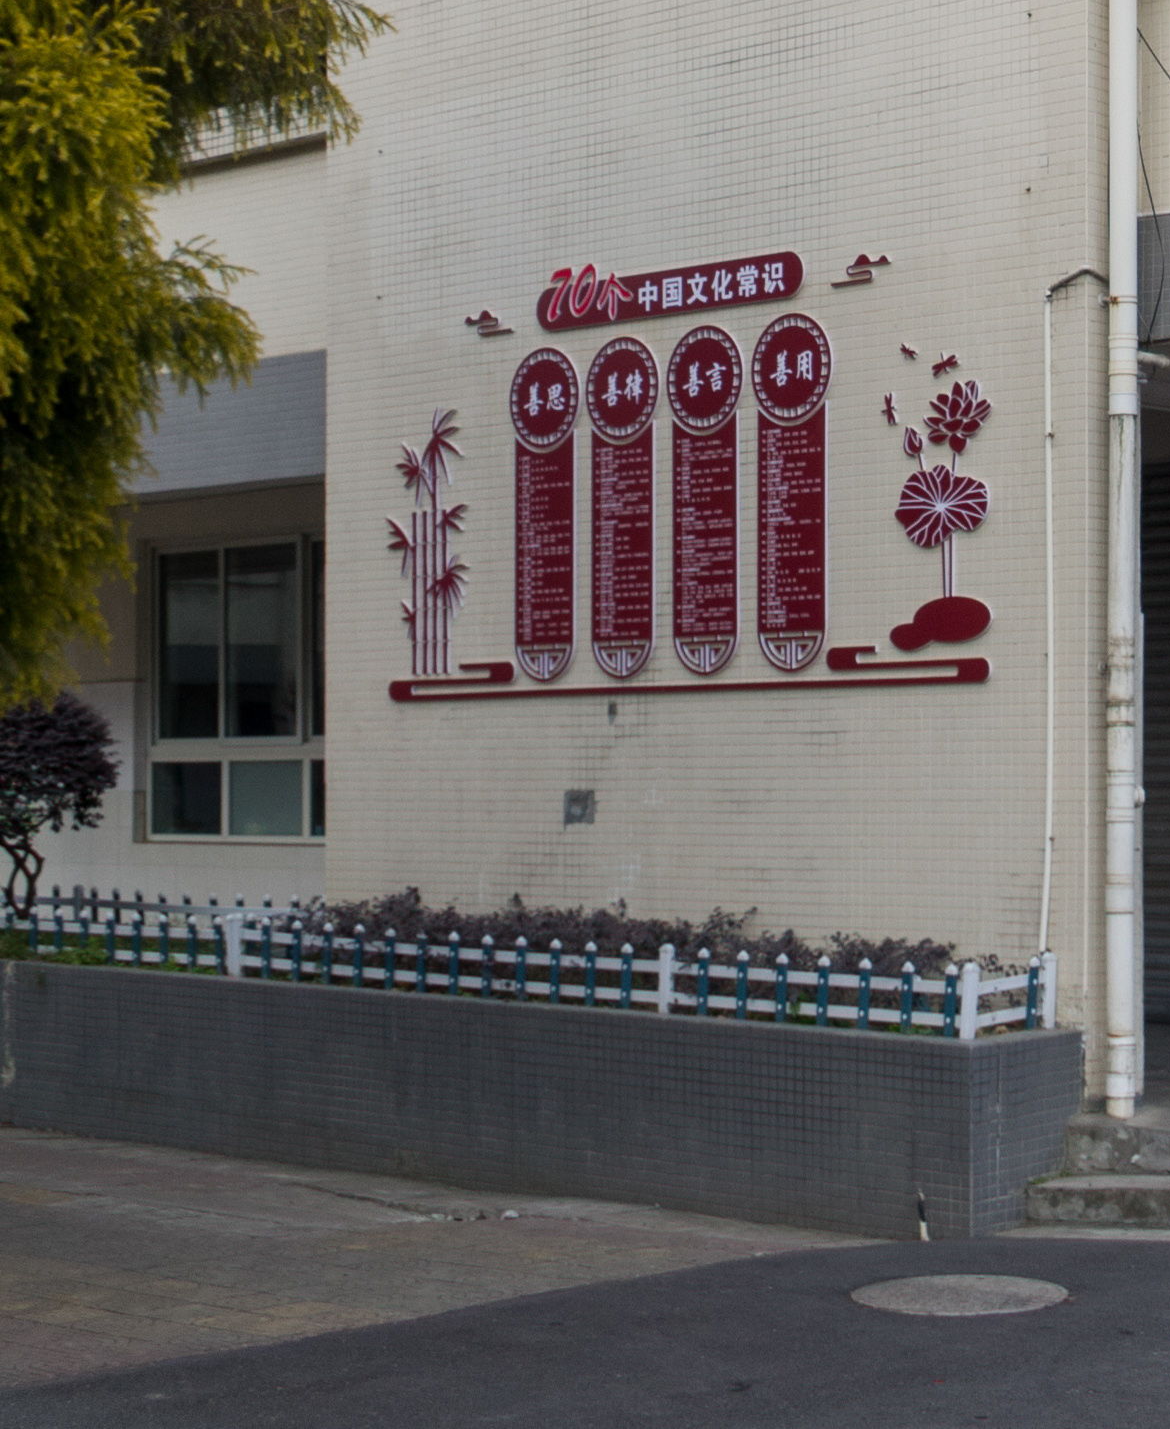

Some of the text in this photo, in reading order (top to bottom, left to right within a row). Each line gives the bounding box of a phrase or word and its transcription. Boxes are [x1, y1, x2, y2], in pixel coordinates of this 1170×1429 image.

[682, 361, 727, 398] 善言
[770, 349, 813, 388] 善用
[524, 382, 566, 417] 善思
